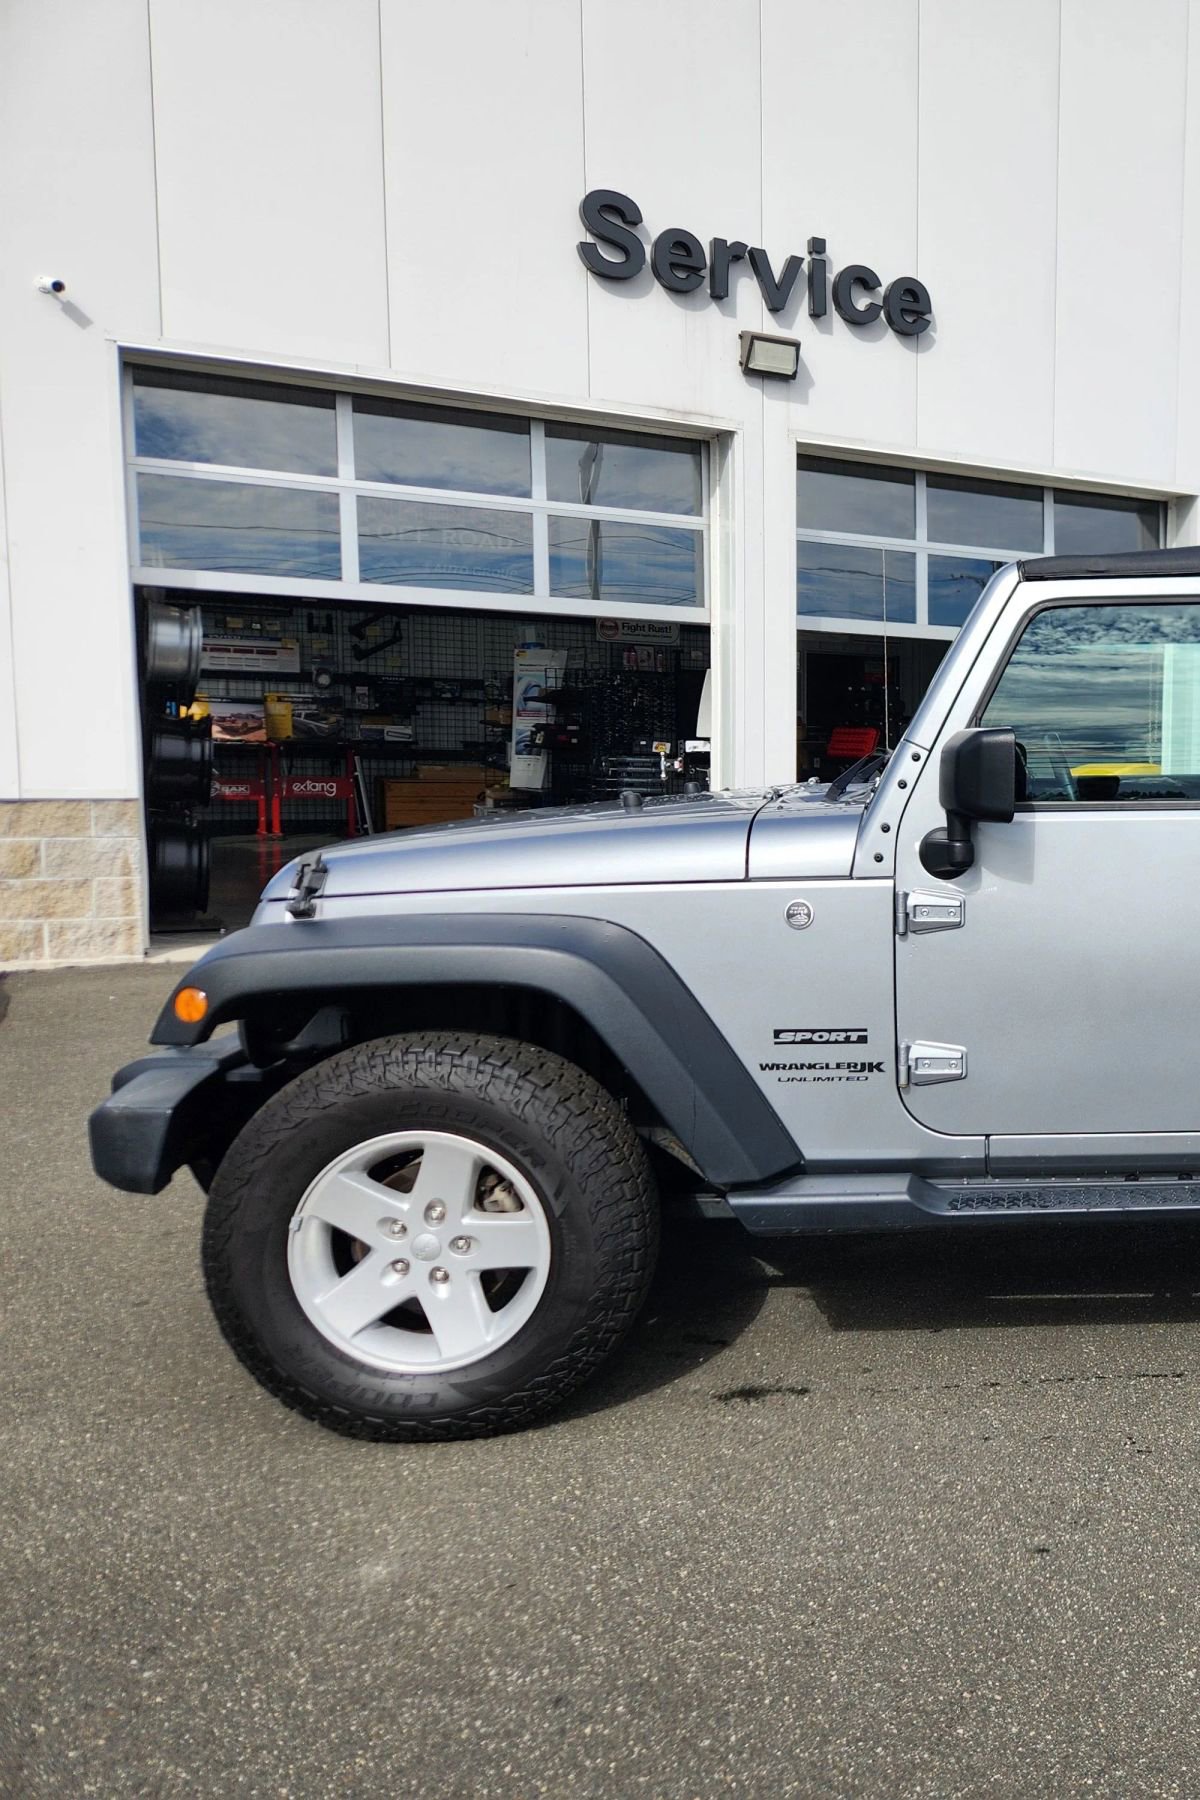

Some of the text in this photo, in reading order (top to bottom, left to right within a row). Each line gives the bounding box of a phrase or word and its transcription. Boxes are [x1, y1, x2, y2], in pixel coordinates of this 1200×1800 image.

[576, 189, 933, 337] Service
[621, 622, 647, 633] Fight
[648, 623, 673, 634] Rust!
[774, 1030, 868, 1043] SPORT
[777, 1075, 869, 1083] UNLIMITED
